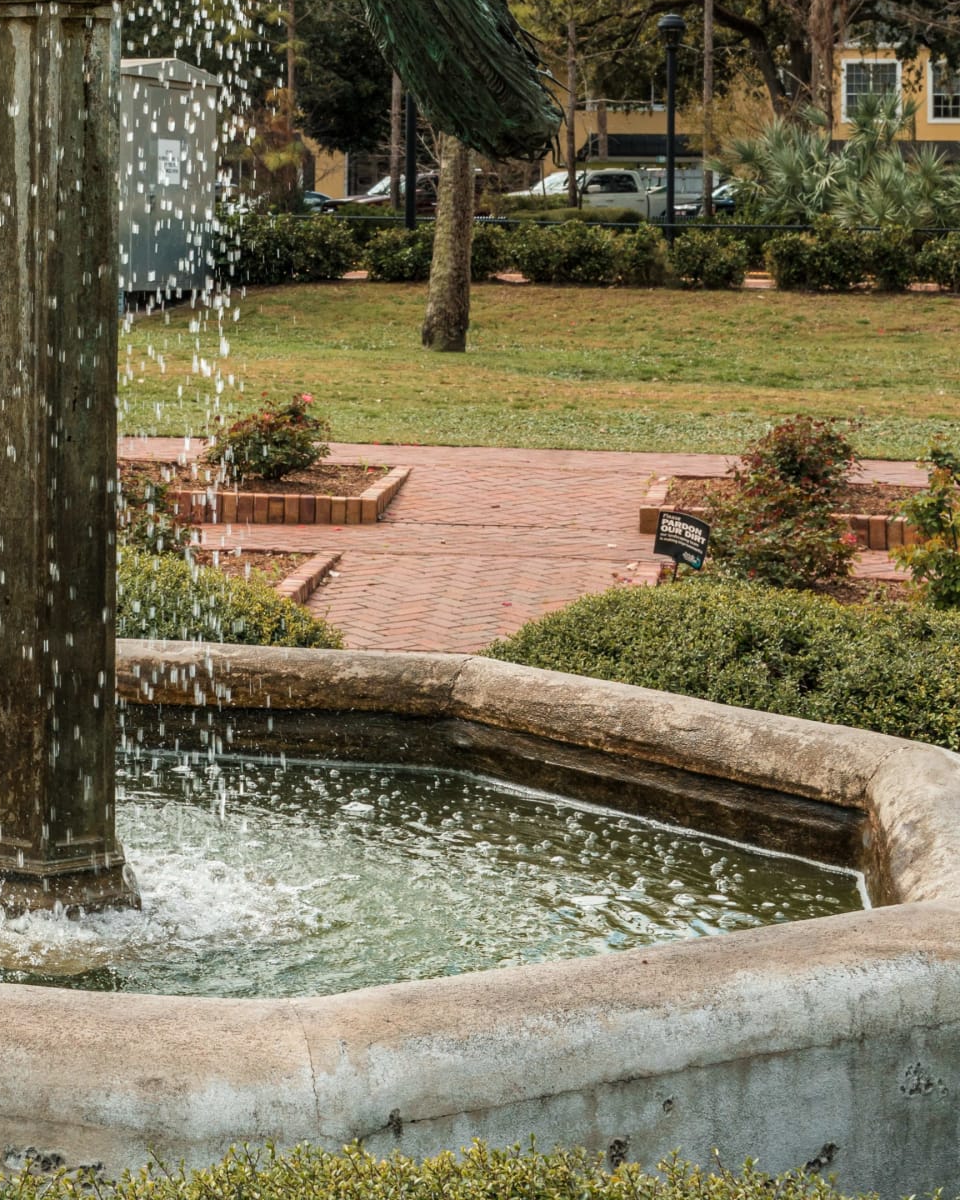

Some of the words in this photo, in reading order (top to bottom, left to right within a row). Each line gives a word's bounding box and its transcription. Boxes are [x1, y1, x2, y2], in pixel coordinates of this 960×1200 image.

[660, 525, 682, 535] OUR
[684, 530, 706, 544] DIRT
[661, 518, 703, 536] PARDON
